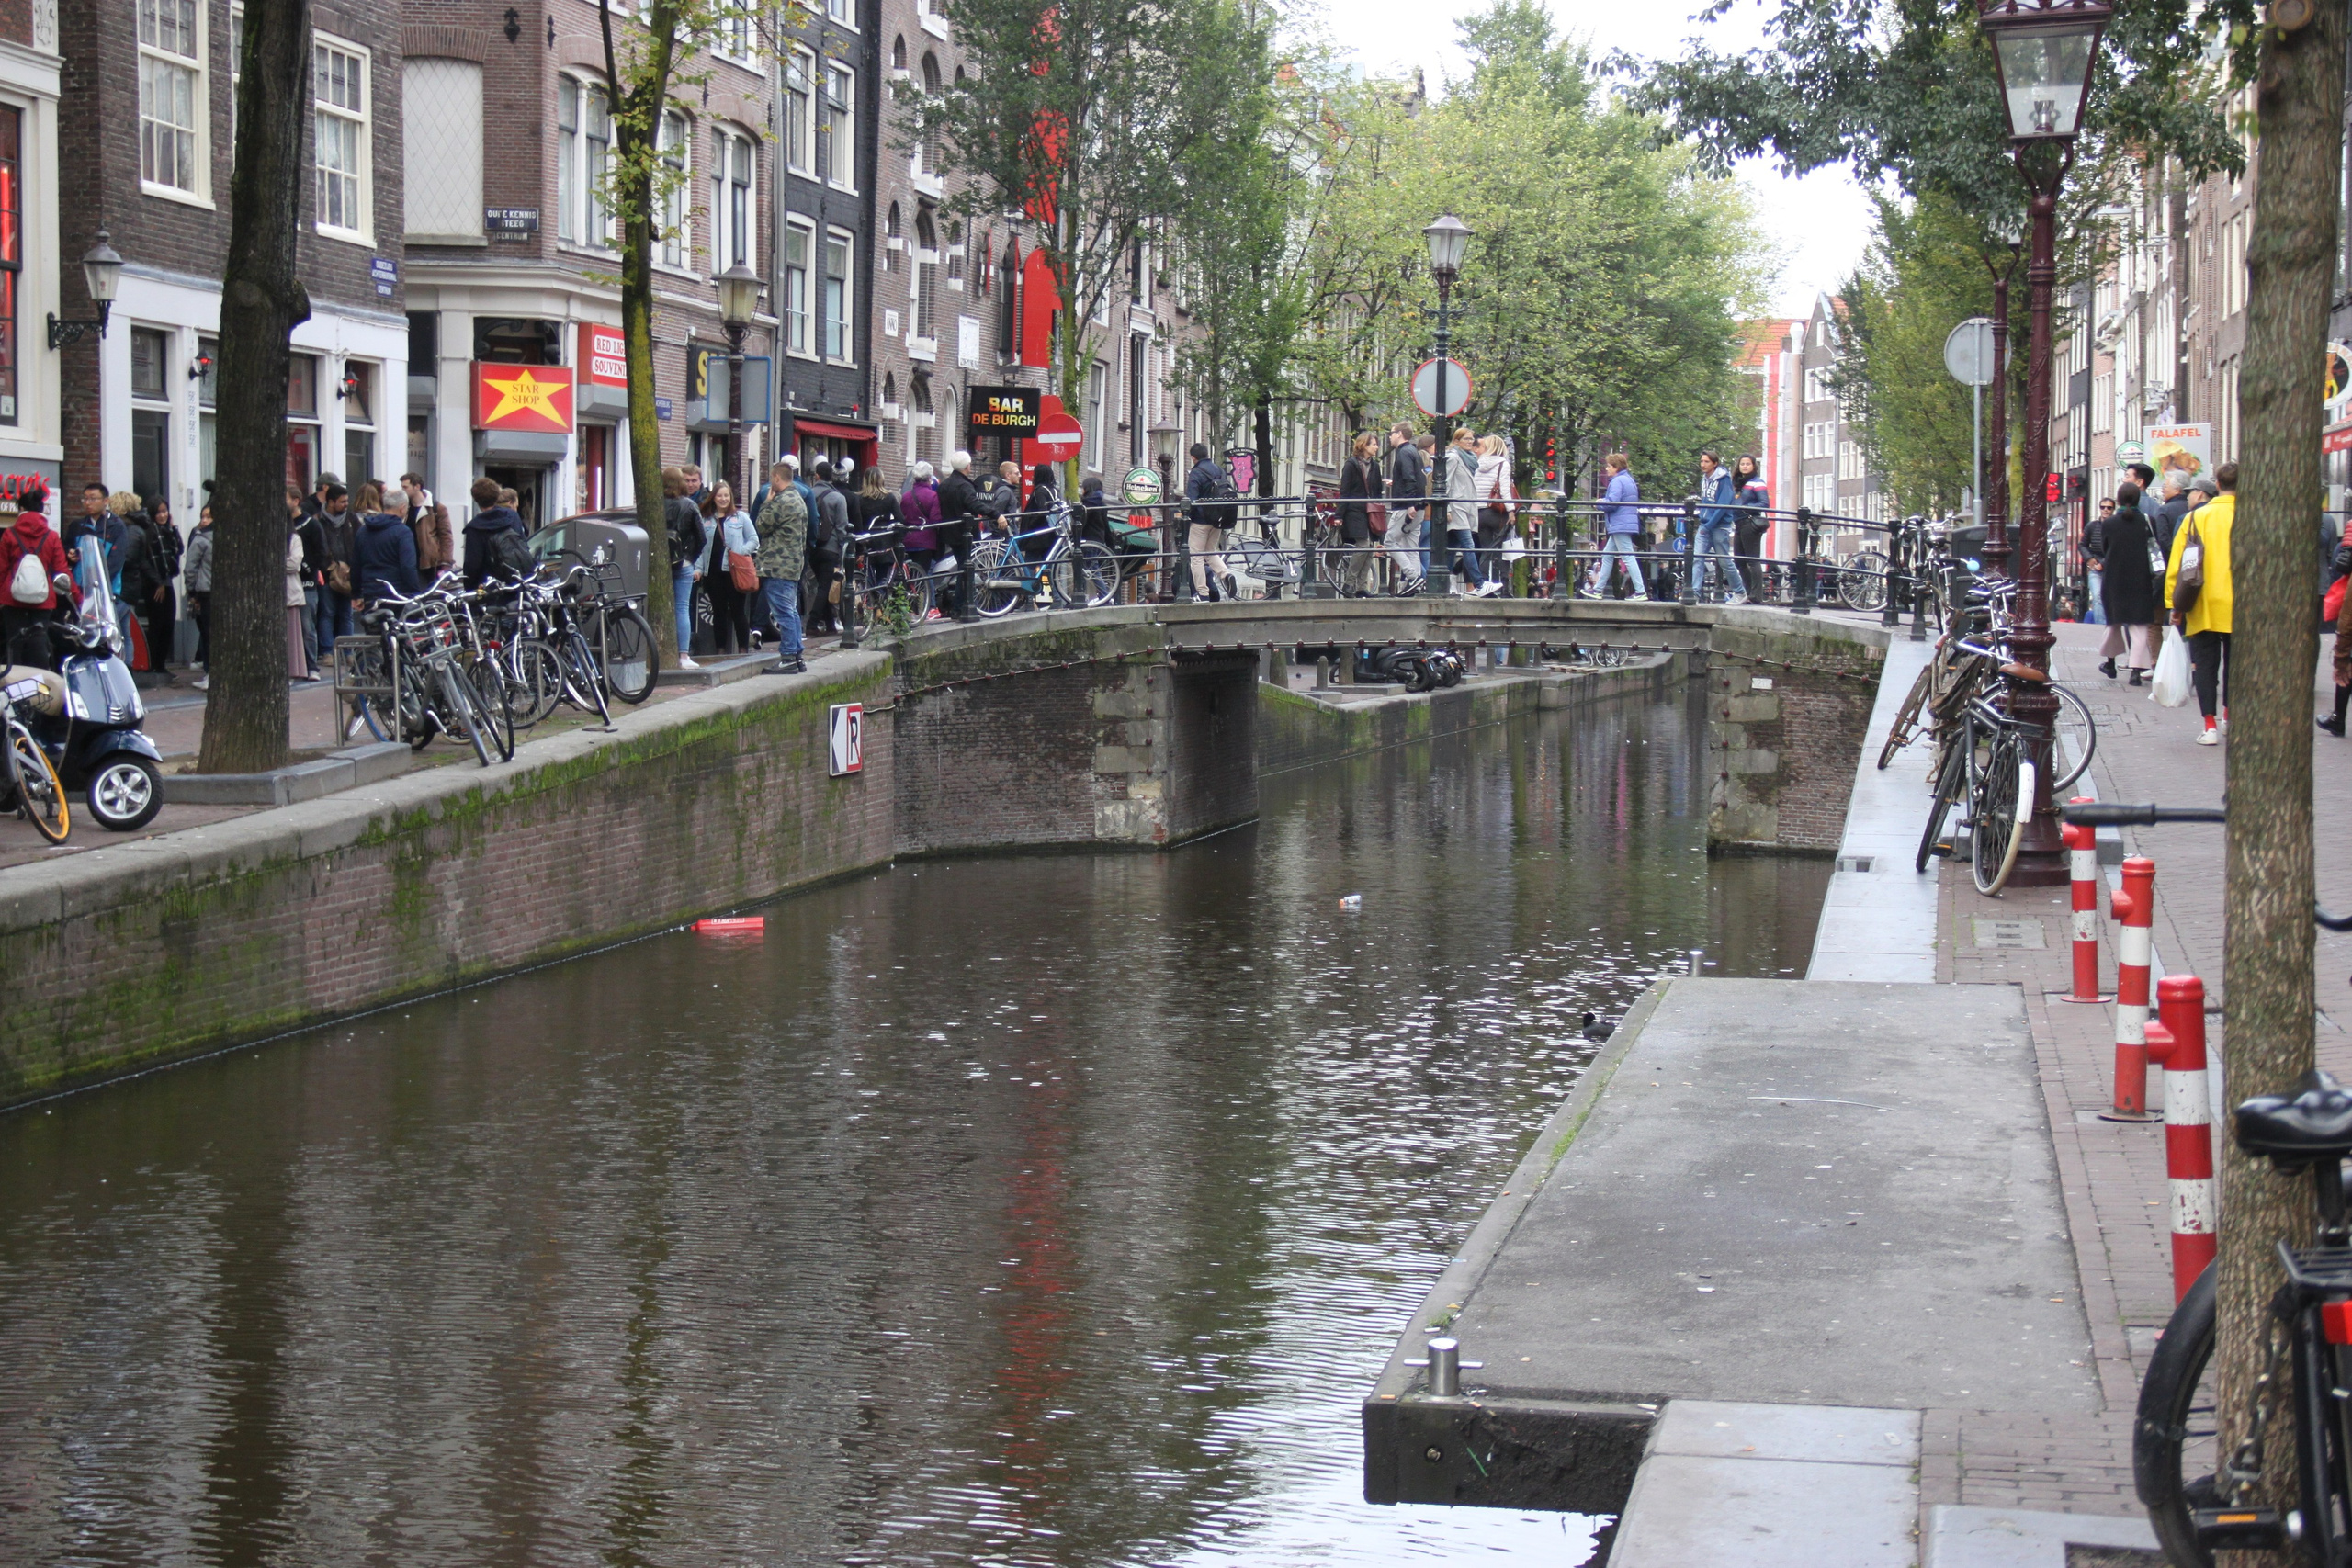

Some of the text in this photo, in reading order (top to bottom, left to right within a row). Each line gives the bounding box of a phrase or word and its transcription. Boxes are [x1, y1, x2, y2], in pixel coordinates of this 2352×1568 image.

[509, 210, 537, 219] KENNIS
[596, 338, 626, 355] RED LIG
[594, 360, 627, 376] SOUVENI
[512, 384, 539, 394] STAR
[512, 395, 540, 405] SHOP
[989, 397, 1023, 413] BAR
[972, 413, 1036, 427] DE BURGH
[2151, 428, 2201, 439] FALAFEL
[1126, 483, 1158, 493] Heineken
